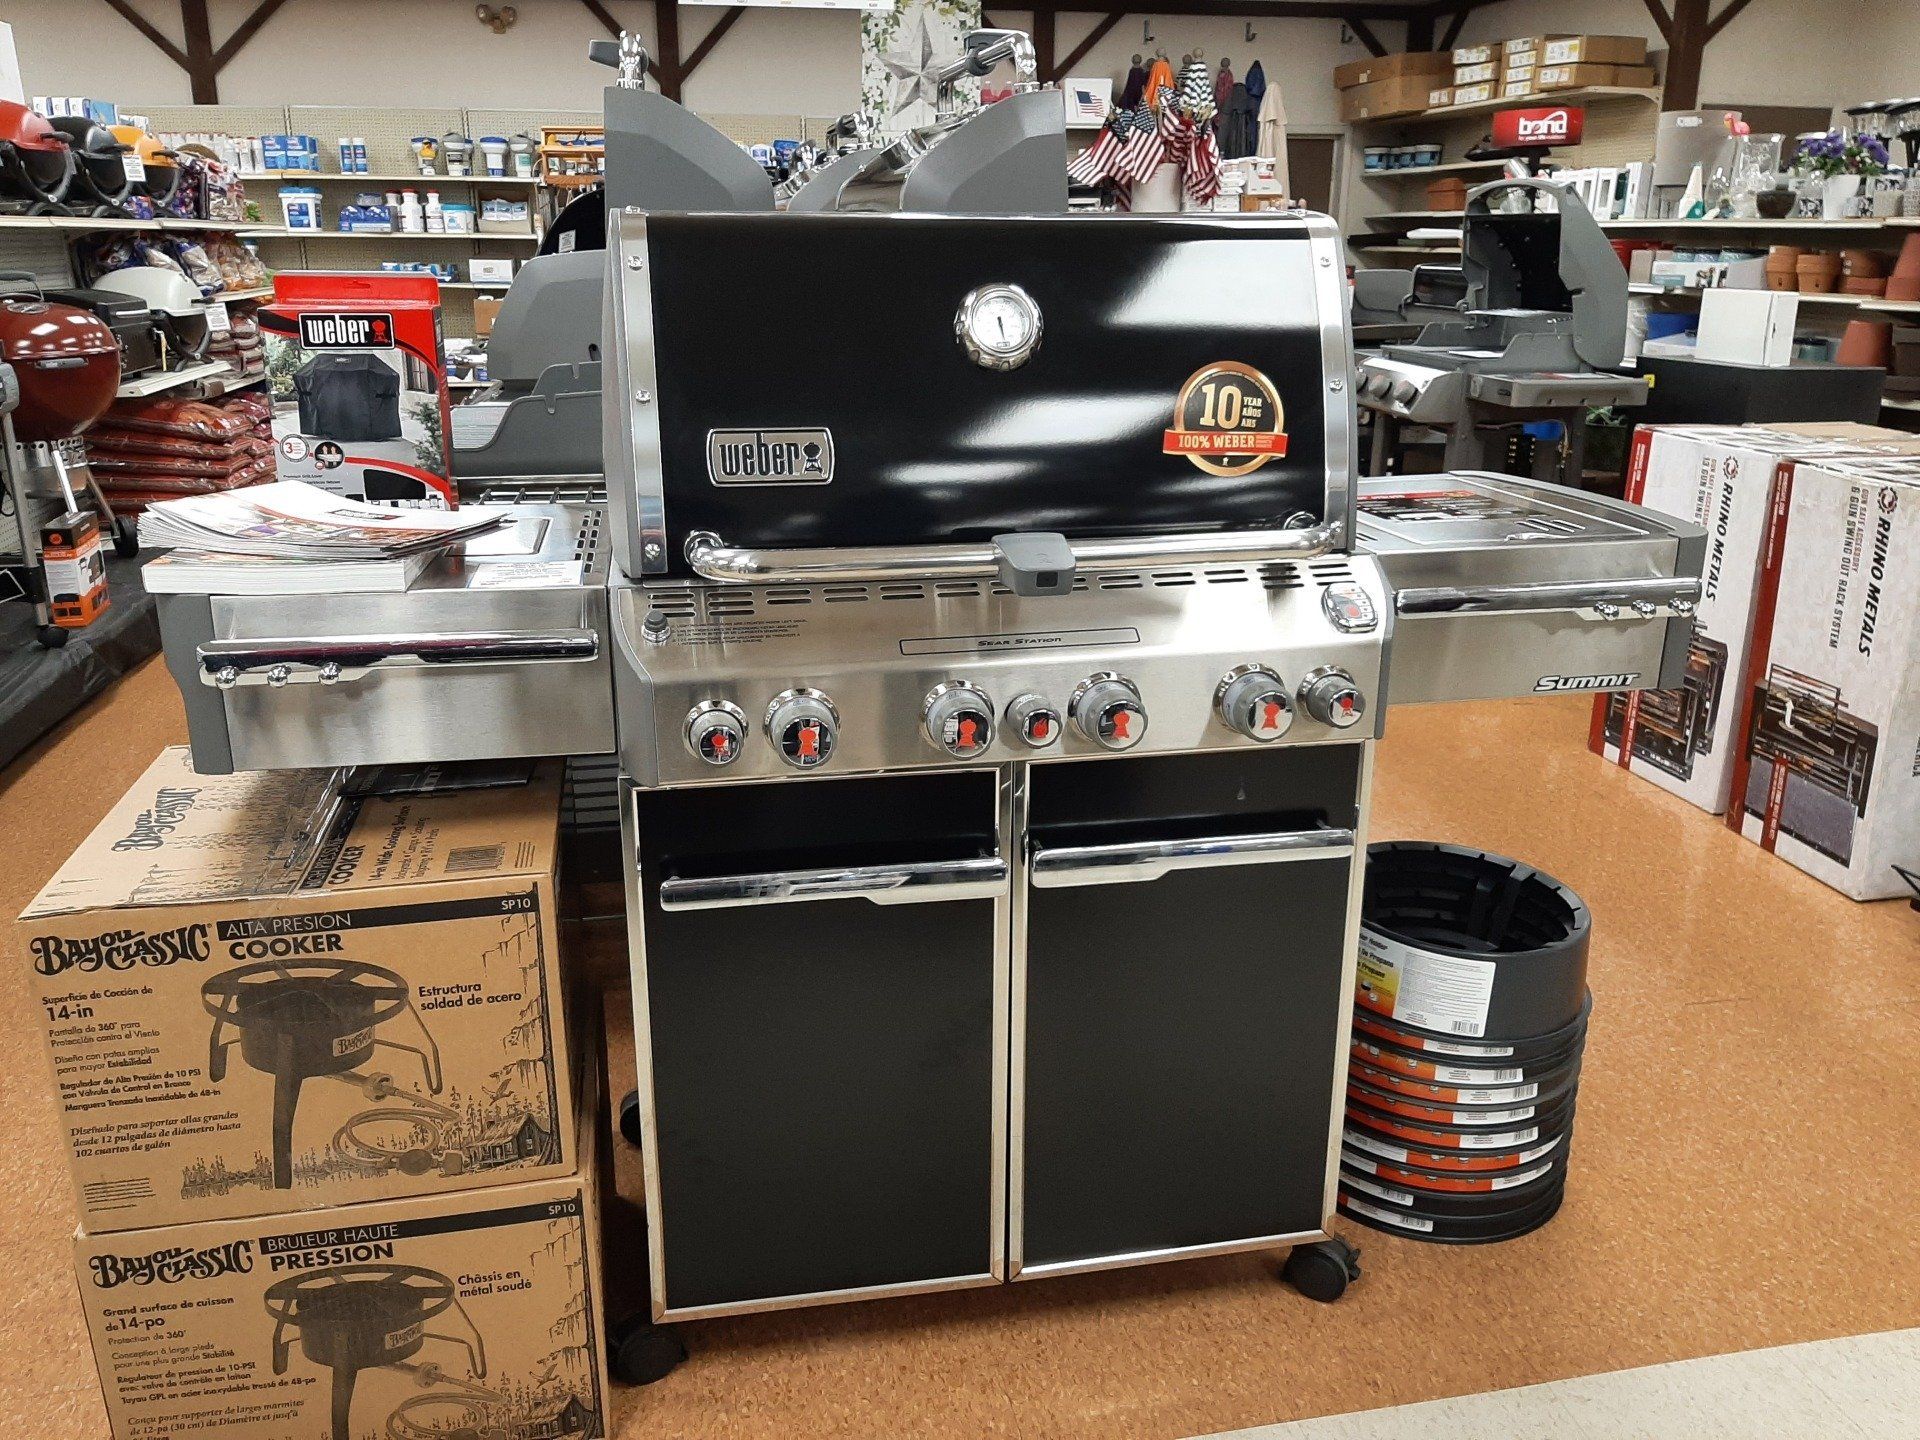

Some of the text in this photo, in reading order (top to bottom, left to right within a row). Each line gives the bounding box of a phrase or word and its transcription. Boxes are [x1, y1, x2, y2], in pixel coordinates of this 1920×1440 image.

[305, 315, 370, 344] weber
[1200, 383, 1242, 429] 10
[1243, 396, 1263, 407] YEAR
[285, 441, 294, 455] 3
[1178, 434, 1211, 449] 100%
[1212, 435, 1255, 448] WEBER
[718, 432, 801, 476] weber
[1700, 468, 1709, 488] GUN
[1693, 489, 1706, 520] SWING
[1848, 496, 1860, 519] GUN
[1705, 481, 1734, 602] RHINO METALS
[1841, 519, 1858, 557] SWING
[1839, 557, 1851, 578] OUT
[1835, 578, 1849, 606] RACK
[1858, 515, 1892, 658] RHINO METALS
[1828, 607, 1844, 649] SYSTEM
[328, 844, 367, 885] COOKER
[500, 897, 532, 911] SP10
[225, 919, 272, 939] ALTA
[228, 932, 344, 962] COOKER
[41, 985, 154, 1006] Superficie de Cocción de
[417, 981, 482, 998] Estructura
[419, 991, 522, 1012] soldad de acero
[46, 1004, 94, 1022] 14-in
[48, 1025, 83, 1038] Pantalla
[84, 1024, 97, 1033] de
[120, 1021, 141, 1031] para
[50, 1028, 161, 1048] Protección contra el Viento
[54, 1053, 84, 1065] Diseño
[84, 1053, 102, 1061] con
[127, 1046, 160, 1058] amplias
[56, 1056, 153, 1077] para mayor Estabilidad
[59, 1067, 202, 1092] Regulador Alta Presión 10 PSI
[62, 1091, 77, 1100] con
[122, 1083, 151, 1094] Control
[64, 1099, 107, 1113] Manguera
[70, 1110, 240, 1137] Diseñado para soportar ollas grandes
[72, 1120, 242, 1148] desde 12 pulgadas diámetro hasta
[75, 1139, 172, 1159] 102 cuartos galón
[547, 1202, 577, 1216] SP10
[344, 1223, 400, 1245] HAUTE
[270, 1242, 395, 1273] PRESSION
[457, 1269, 522, 1287] Châssis en
[459, 1278, 533, 1299] métal soudé
[102, 1295, 236, 1318] Grand surface de cuisson
[104, 1315, 166, 1333] de 14-po
[107, 1334, 151, 1346] Protection
[111, 1348, 160, 1361] Conception
[168, 1344, 191, 1357] large
[113, 1361, 134, 1372] pour
[135, 1359, 151, 1367] une
[152, 1356, 170, 1368] plus
[170, 1353, 201, 1365] grande
[177, 1365, 215, 1379] pression
[228, 1360, 257, 1373] 10-PSI
[141, 1381, 165, 1391] valve
[148, 1391, 167, 1401] GPL
[180, 1388, 202, 1398] acier
[202, 1381, 251, 1396] inoxydable
[290, 1376, 318, 1387] 48-po
[127, 1399, 305, 1427] Conçu pour supporter larges marmites
[218, 1412, 261, 1427] Diamètre
